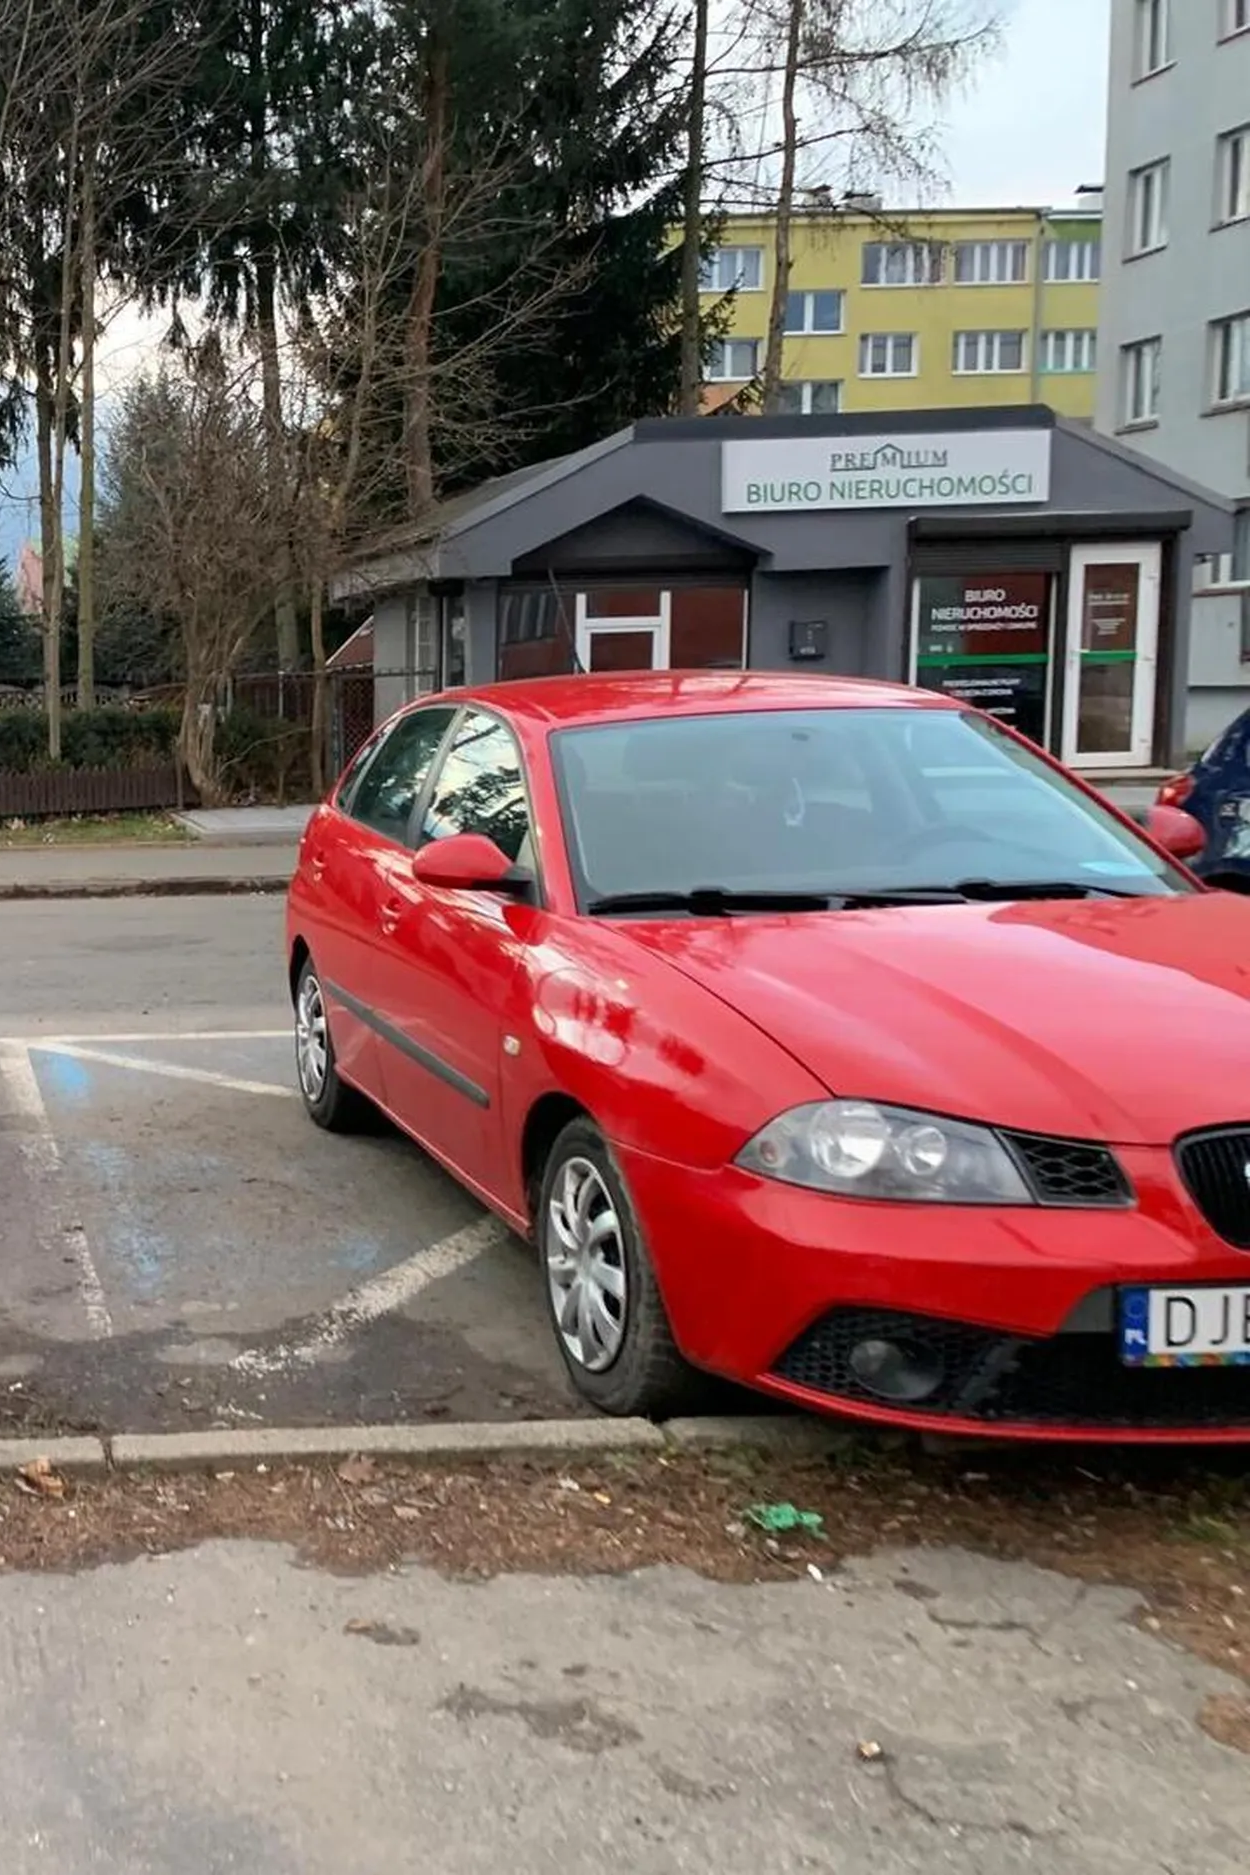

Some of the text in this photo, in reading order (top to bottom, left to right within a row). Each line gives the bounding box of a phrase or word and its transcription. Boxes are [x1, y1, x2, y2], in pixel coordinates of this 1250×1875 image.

[830, 449, 948, 471] PREMIUM
[746, 469, 1033, 504] BIURO NIERUCHOMOŚCI
[964, 588, 1006, 602] BIURO
[931, 603, 1039, 620] NIERUCHOMOŚCI
